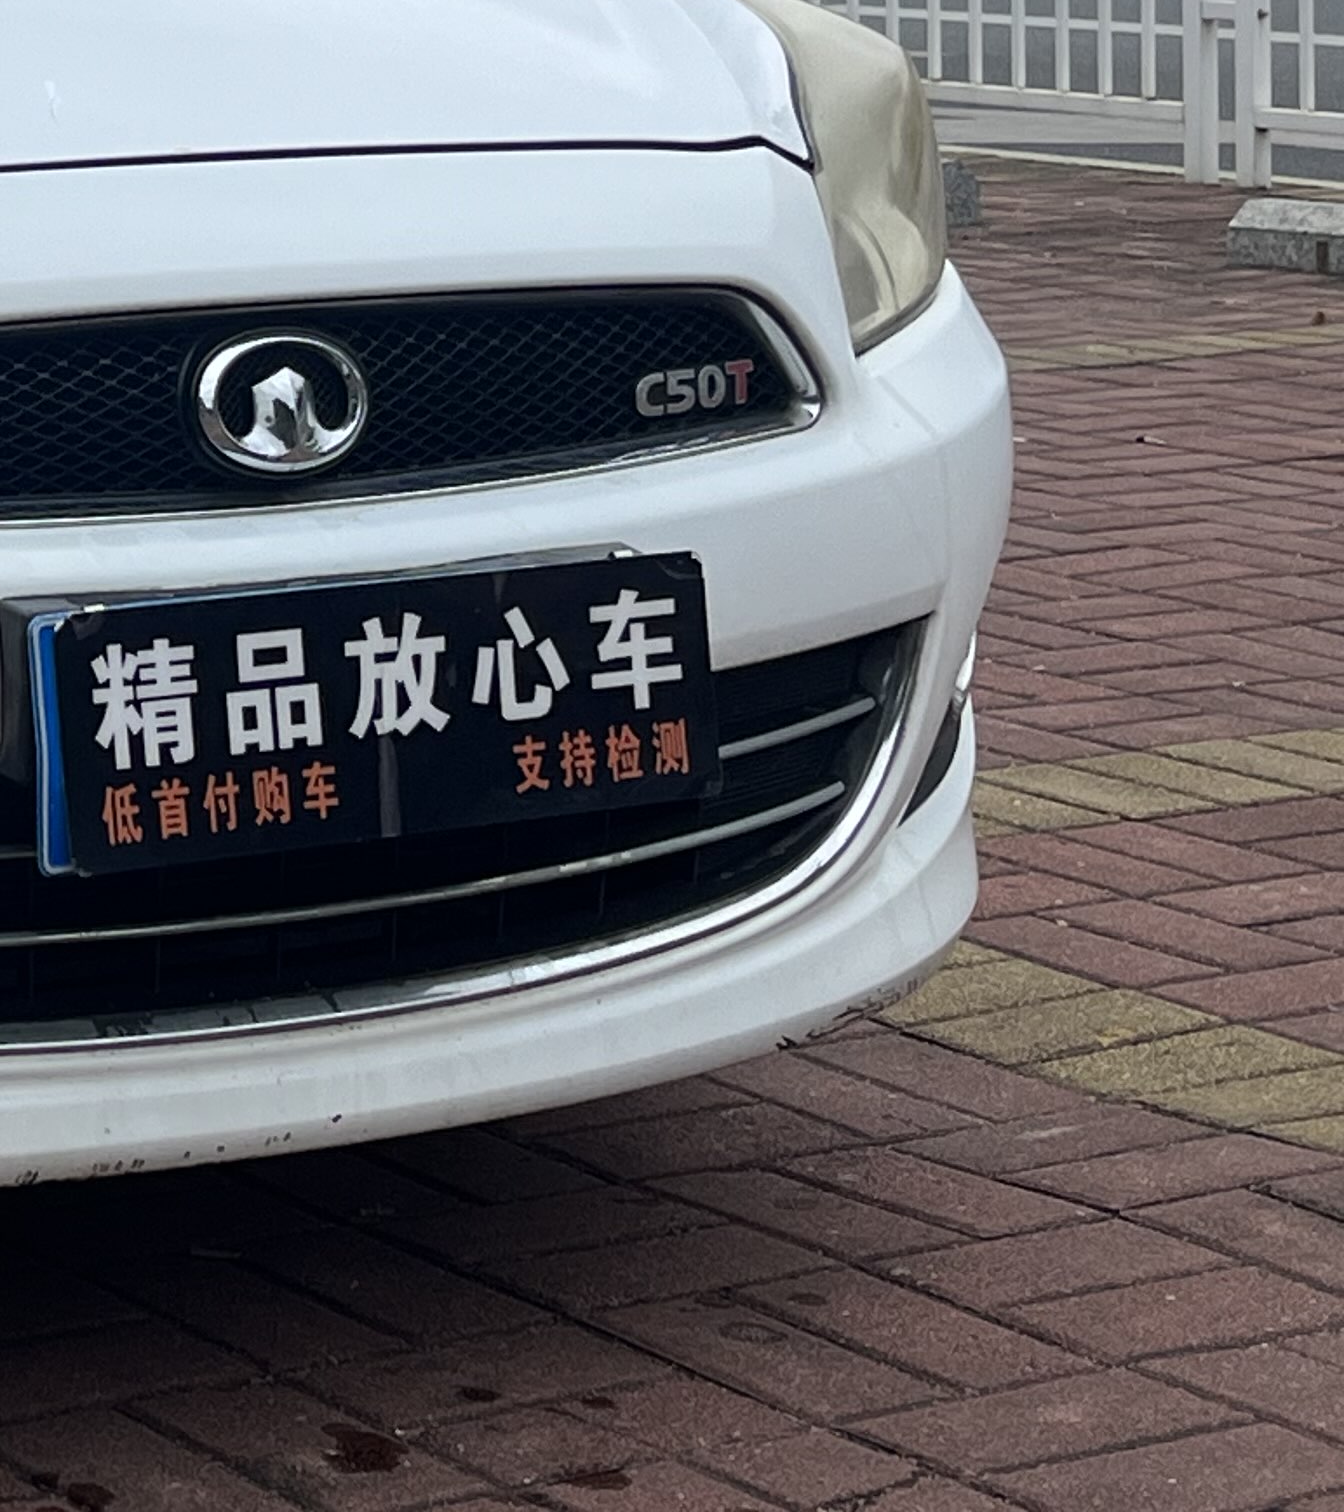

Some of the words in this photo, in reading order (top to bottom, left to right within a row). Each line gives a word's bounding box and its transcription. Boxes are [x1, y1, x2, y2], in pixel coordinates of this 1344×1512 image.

[635, 359, 754, 417] C50T
[91, 589, 684, 770] 精品放心车
[102, 761, 340, 846] 低首付购车
[514, 717, 691, 795] 支持检测
